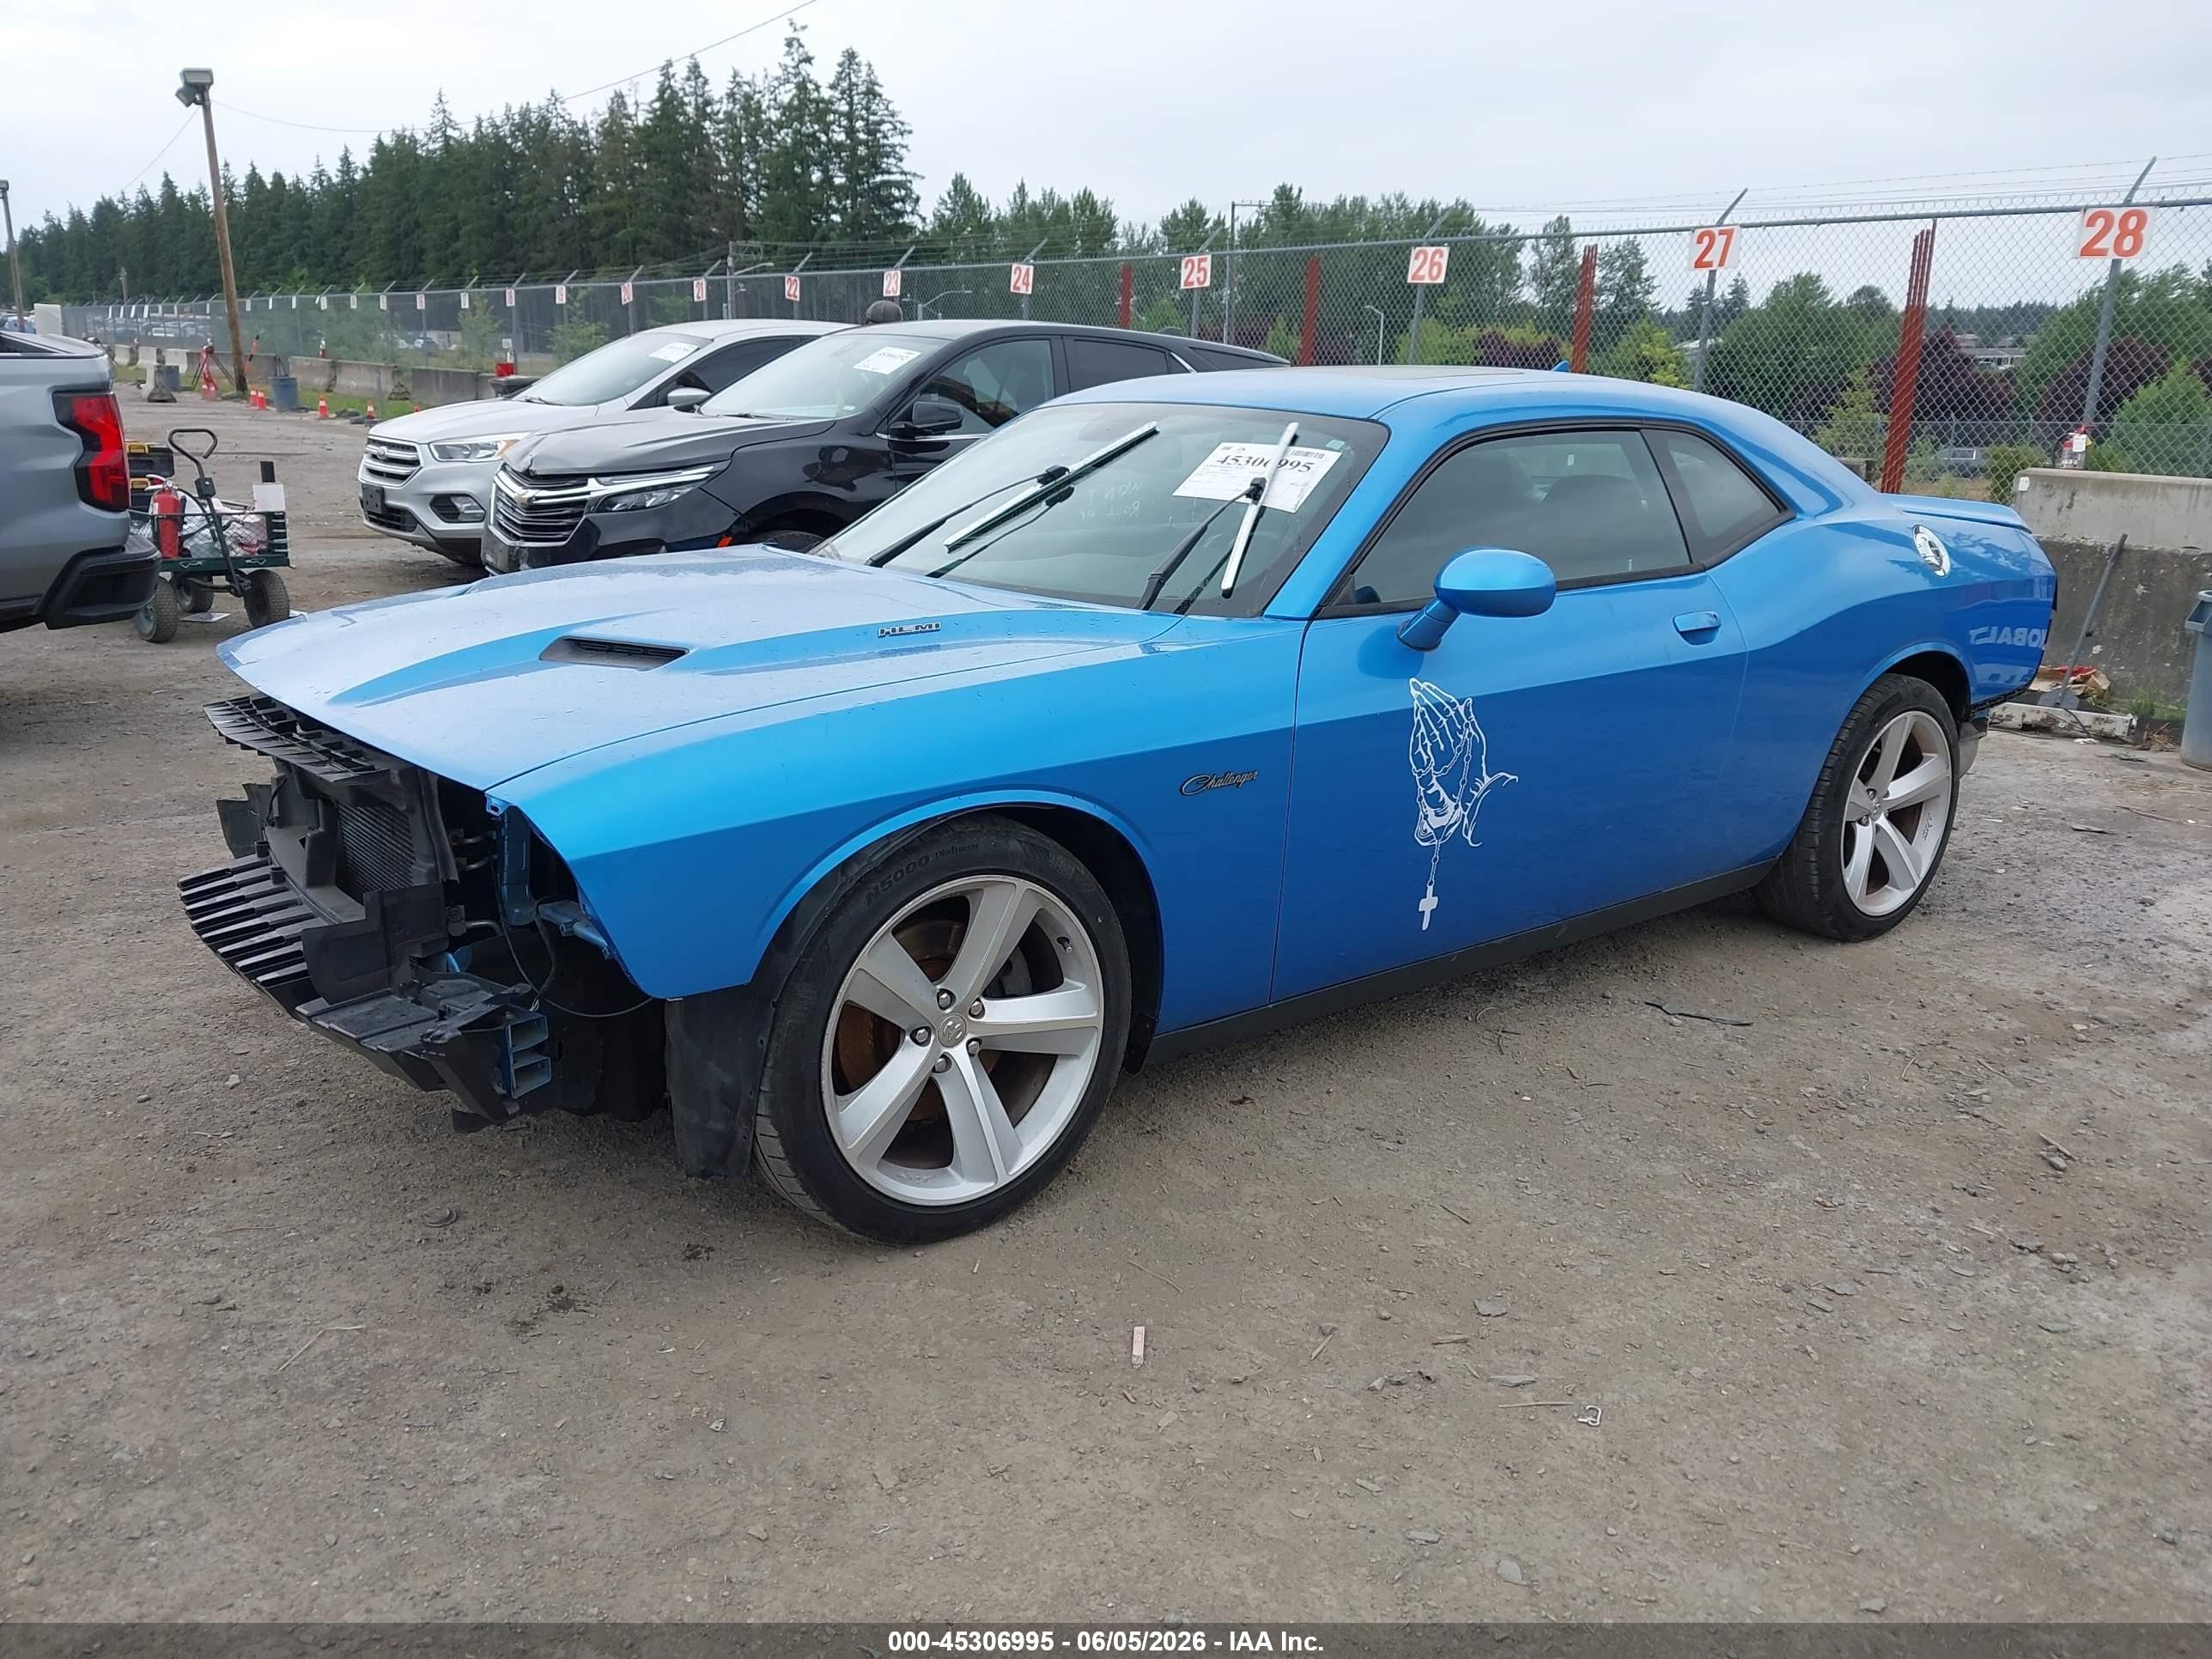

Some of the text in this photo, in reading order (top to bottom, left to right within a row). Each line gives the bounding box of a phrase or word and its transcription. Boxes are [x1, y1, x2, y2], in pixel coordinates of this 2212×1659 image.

[2081, 210, 2148, 257] 28
[1694, 229, 1734, 268] 27
[1012, 265, 1030, 293] 24
[1183, 257, 1207, 287] 25
[1412, 249, 1443, 281] 26
[696, 280, 704, 300] 21
[787, 276, 798, 299] 22
[884, 272, 899, 295] 23
[878, 623, 941, 638] HEMI
[1181, 771, 1258, 795] Challenger
[865, 854, 930, 907] N5000
